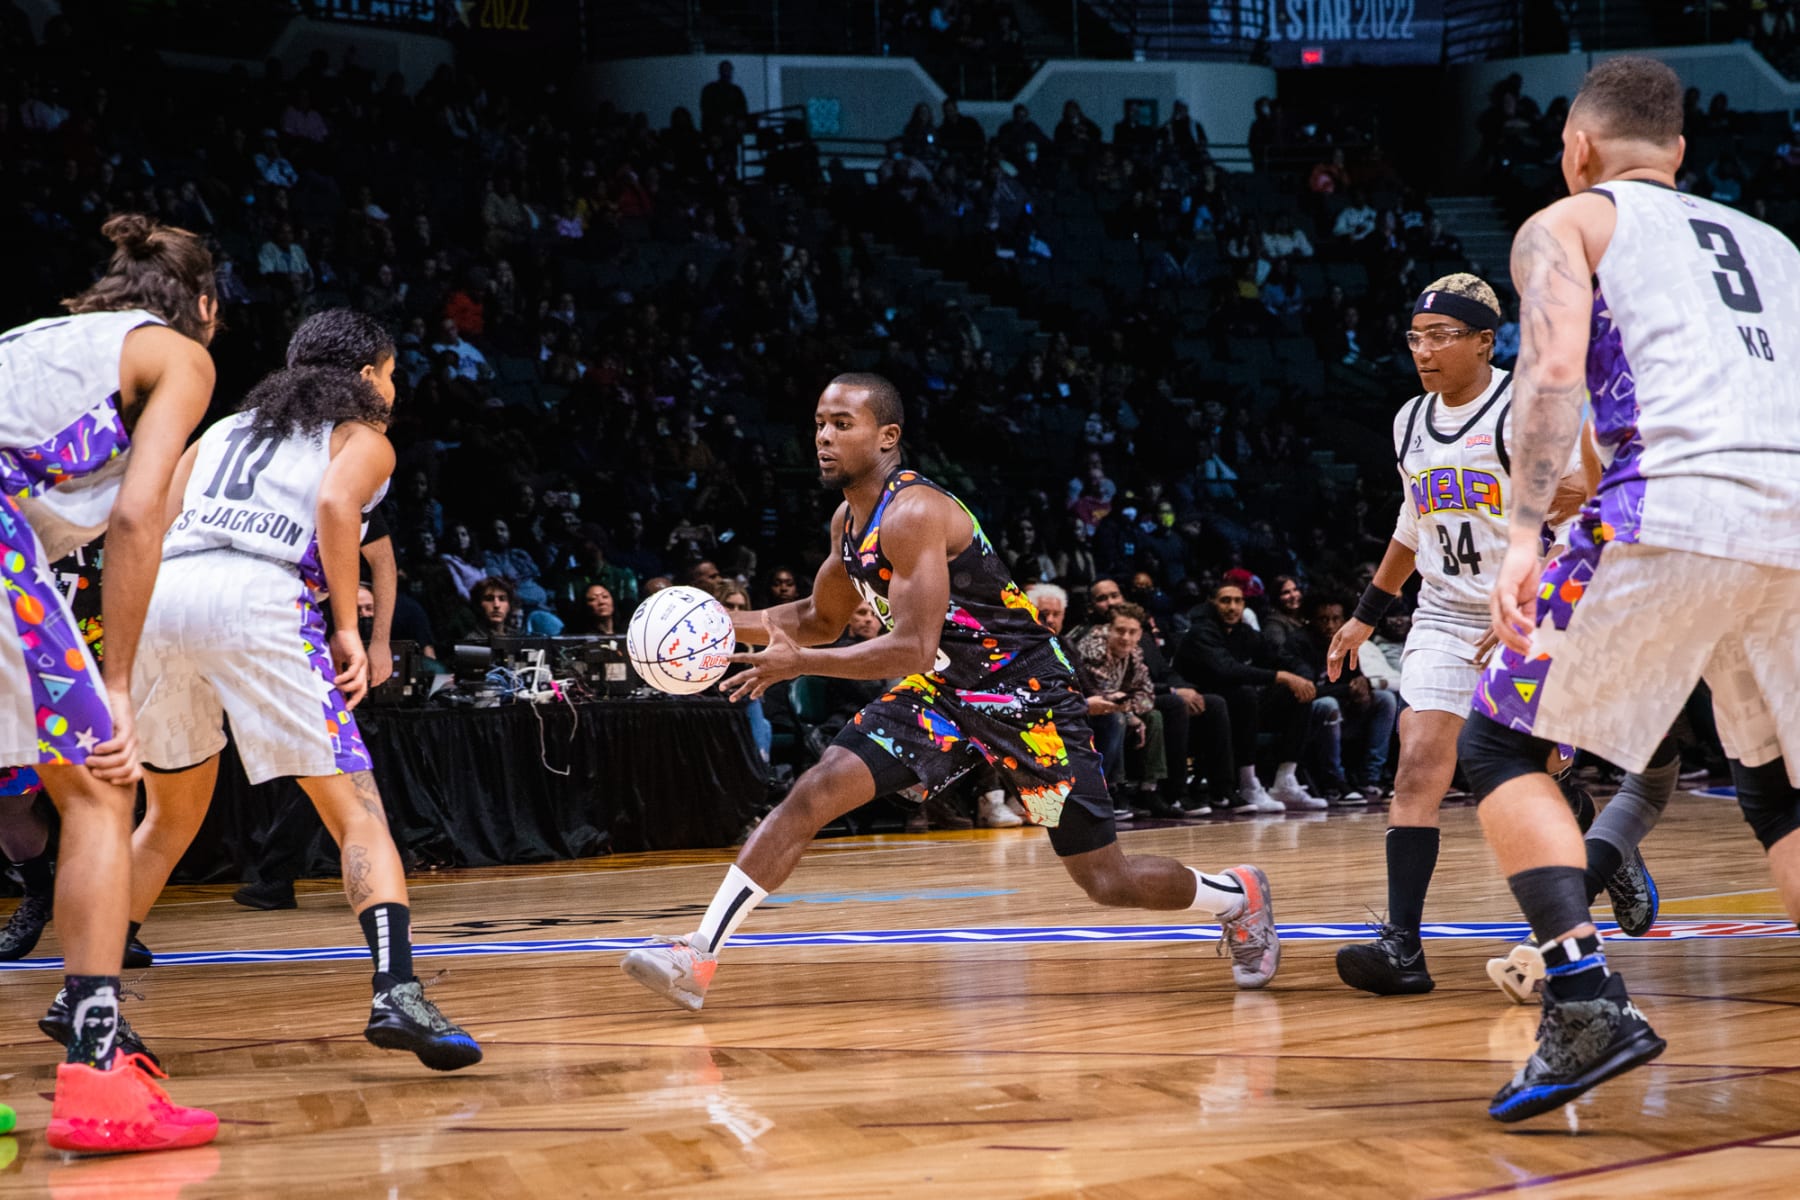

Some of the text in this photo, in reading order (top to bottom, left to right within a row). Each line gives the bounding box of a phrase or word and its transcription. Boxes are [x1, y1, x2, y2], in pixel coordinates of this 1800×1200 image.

[480, 0, 531, 30] 2022
[1285, 0, 1351, 41] STAR
[1355, 0, 1416, 40] 2022
[1688, 218, 1763, 314] 3
[1737, 325, 1775, 362] KB
[203, 425, 284, 501] 10
[1408, 466, 1505, 520] NBA
[201, 506, 304, 547] JACKSON
[1436, 521, 1482, 576] 34
